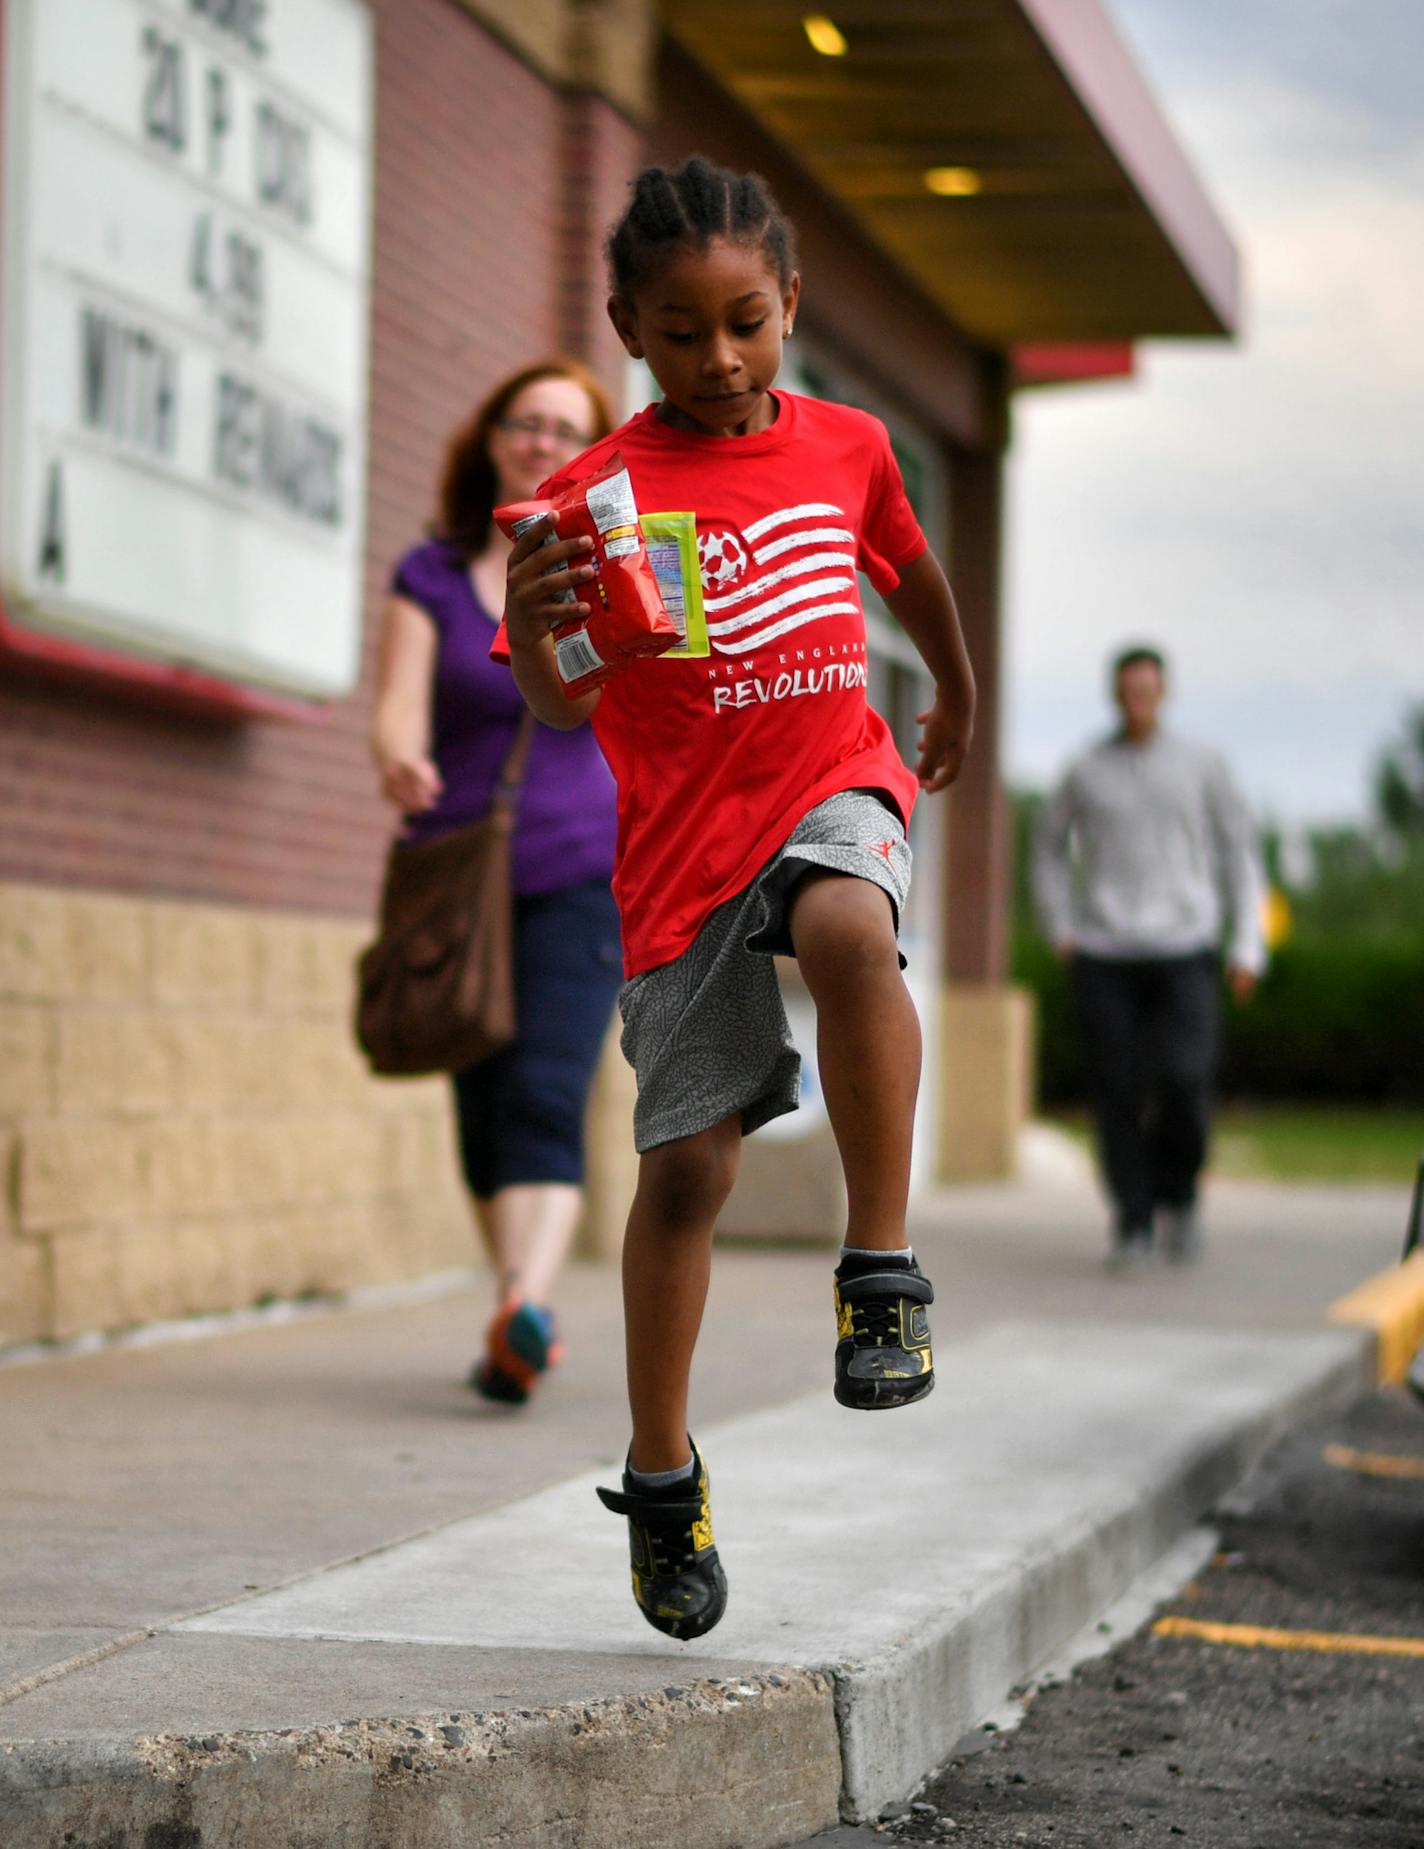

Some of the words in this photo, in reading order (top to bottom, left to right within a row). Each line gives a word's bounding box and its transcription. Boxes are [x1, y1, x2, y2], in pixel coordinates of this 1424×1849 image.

[36, 455, 68, 588] A
[708, 660, 754, 680] NEW
[713, 661, 867, 714] REVOLUTION
